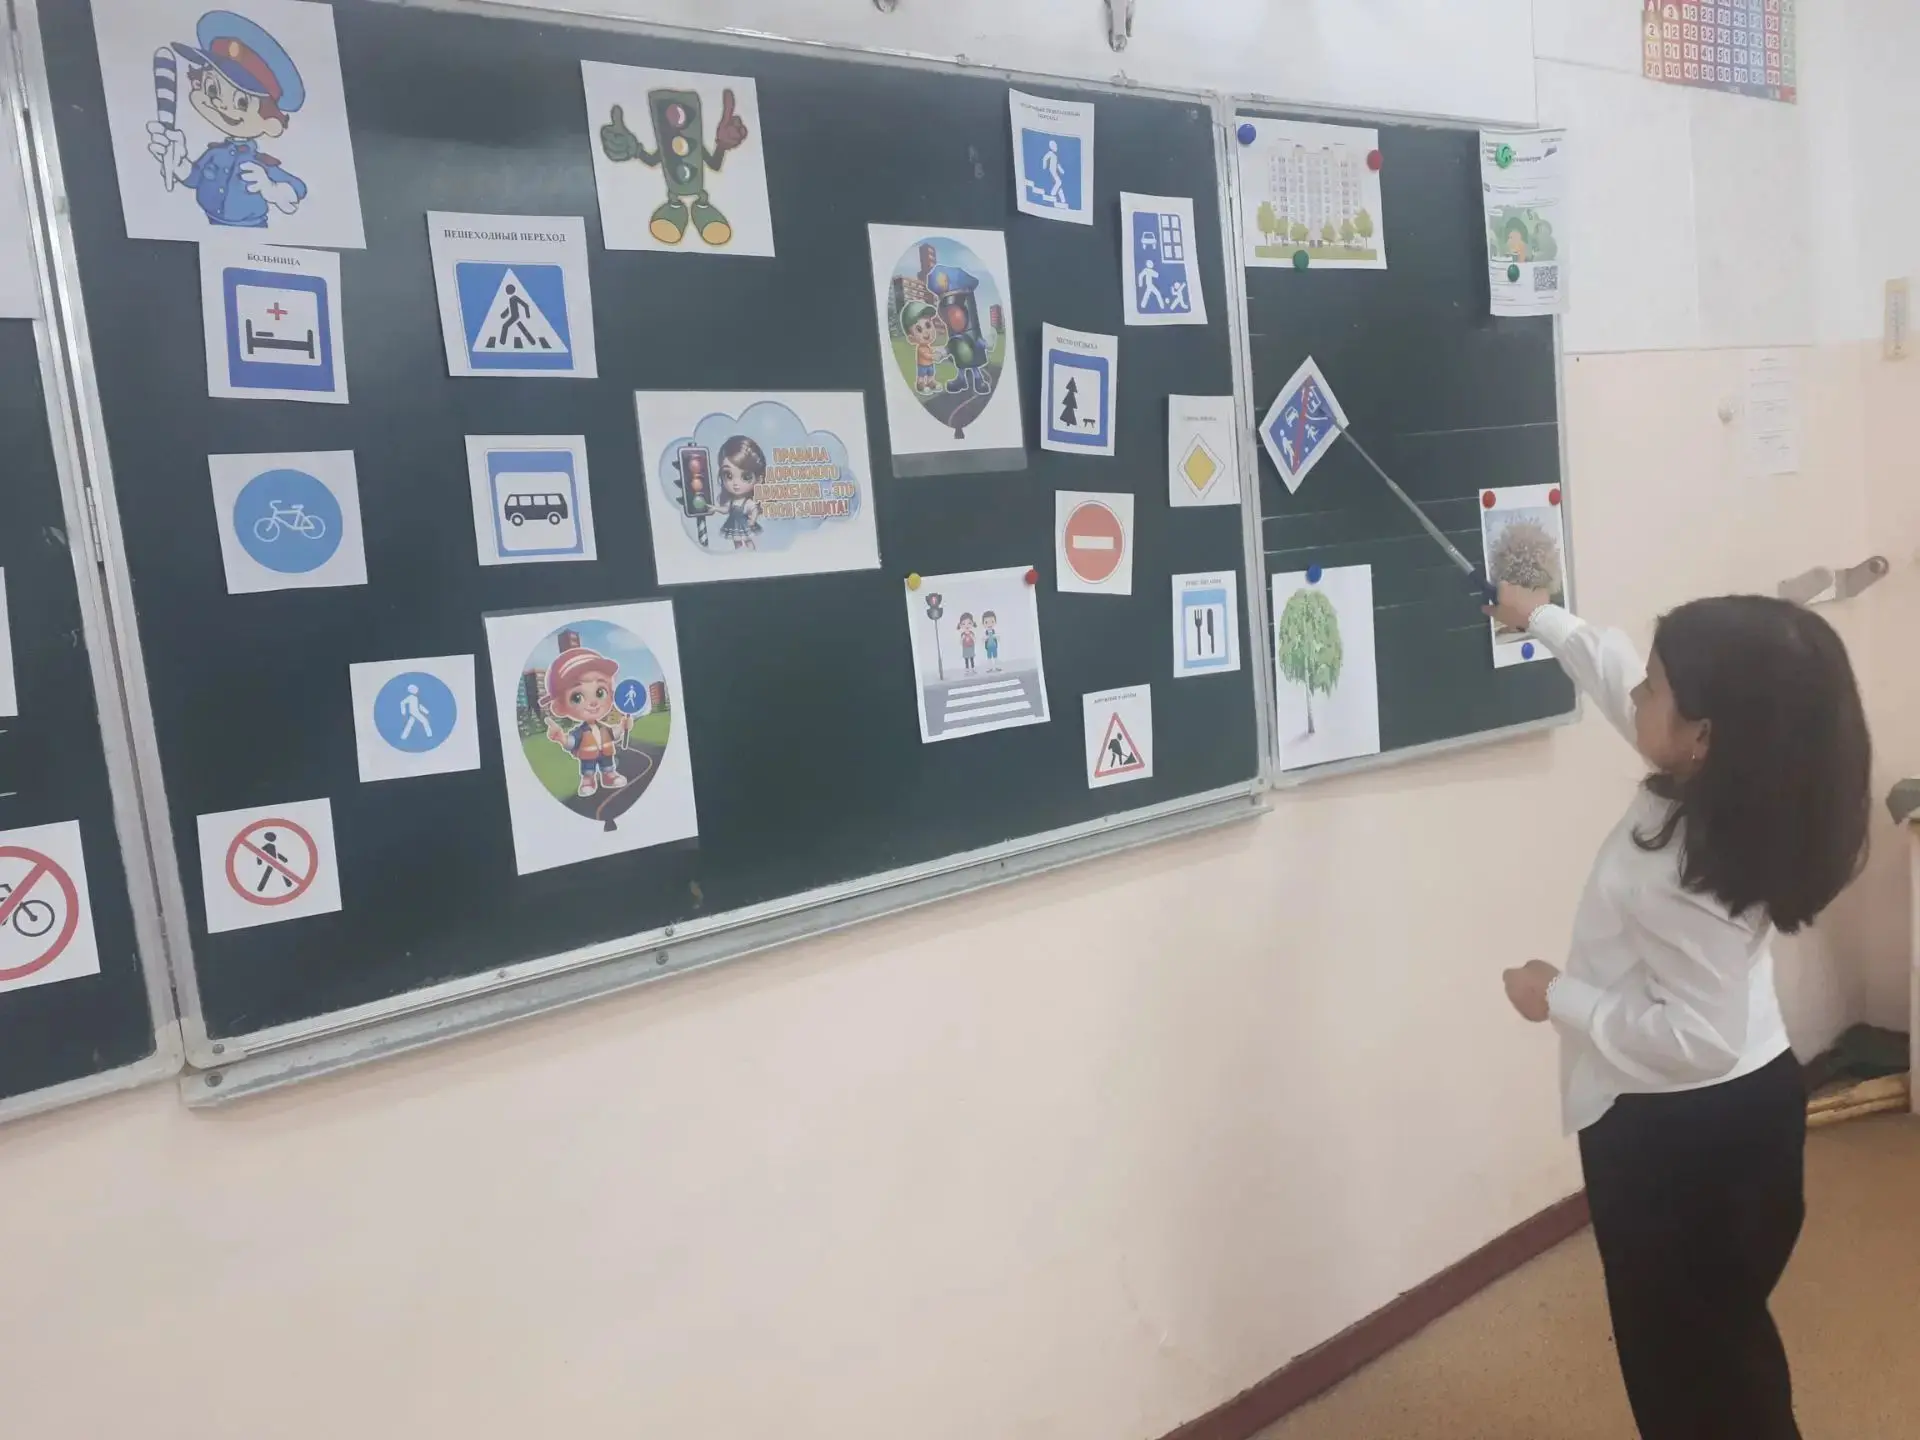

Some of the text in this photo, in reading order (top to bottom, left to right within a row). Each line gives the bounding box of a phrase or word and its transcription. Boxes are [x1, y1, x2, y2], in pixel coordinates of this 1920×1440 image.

[1684, 5, 1696, 19] 13
[1702, 8, 1713, 22] 23
[1665, 25, 1678, 38] 12
[1684, 25, 1697, 39] 22
[1702, 27, 1713, 40] 32
[1719, 30, 1729, 43] 42
[1665, 45, 1678, 58] 21
[1685, 46, 1697, 59] 31
[1702, 49, 1713, 61] 41
[1718, 50, 1730, 63] 51
[1646, 63, 1660, 75] 20
[1667, 64, 1679, 77] 30
[1685, 65, 1698, 79] 40
[1702, 67, 1713, 80] 50
[1719, 67, 1730, 80] 60
[1735, 69, 1747, 82] 70
[443, 229, 566, 242] ПЕШЕХОДНЫЙ ПЕРЕХОД
[247, 253, 301, 266] БОЛЬНИЦА
[772, 447, 831, 463] ПРАВИЛА
[765, 465, 841, 483] ДОРОЖНОГО
[754, 483, 821, 501] ДВИЖЕНИЯ
[832, 481, 856, 498] ЭТО
[762, 498, 850, 518] ТВОЯ ЗАЩИТА!
